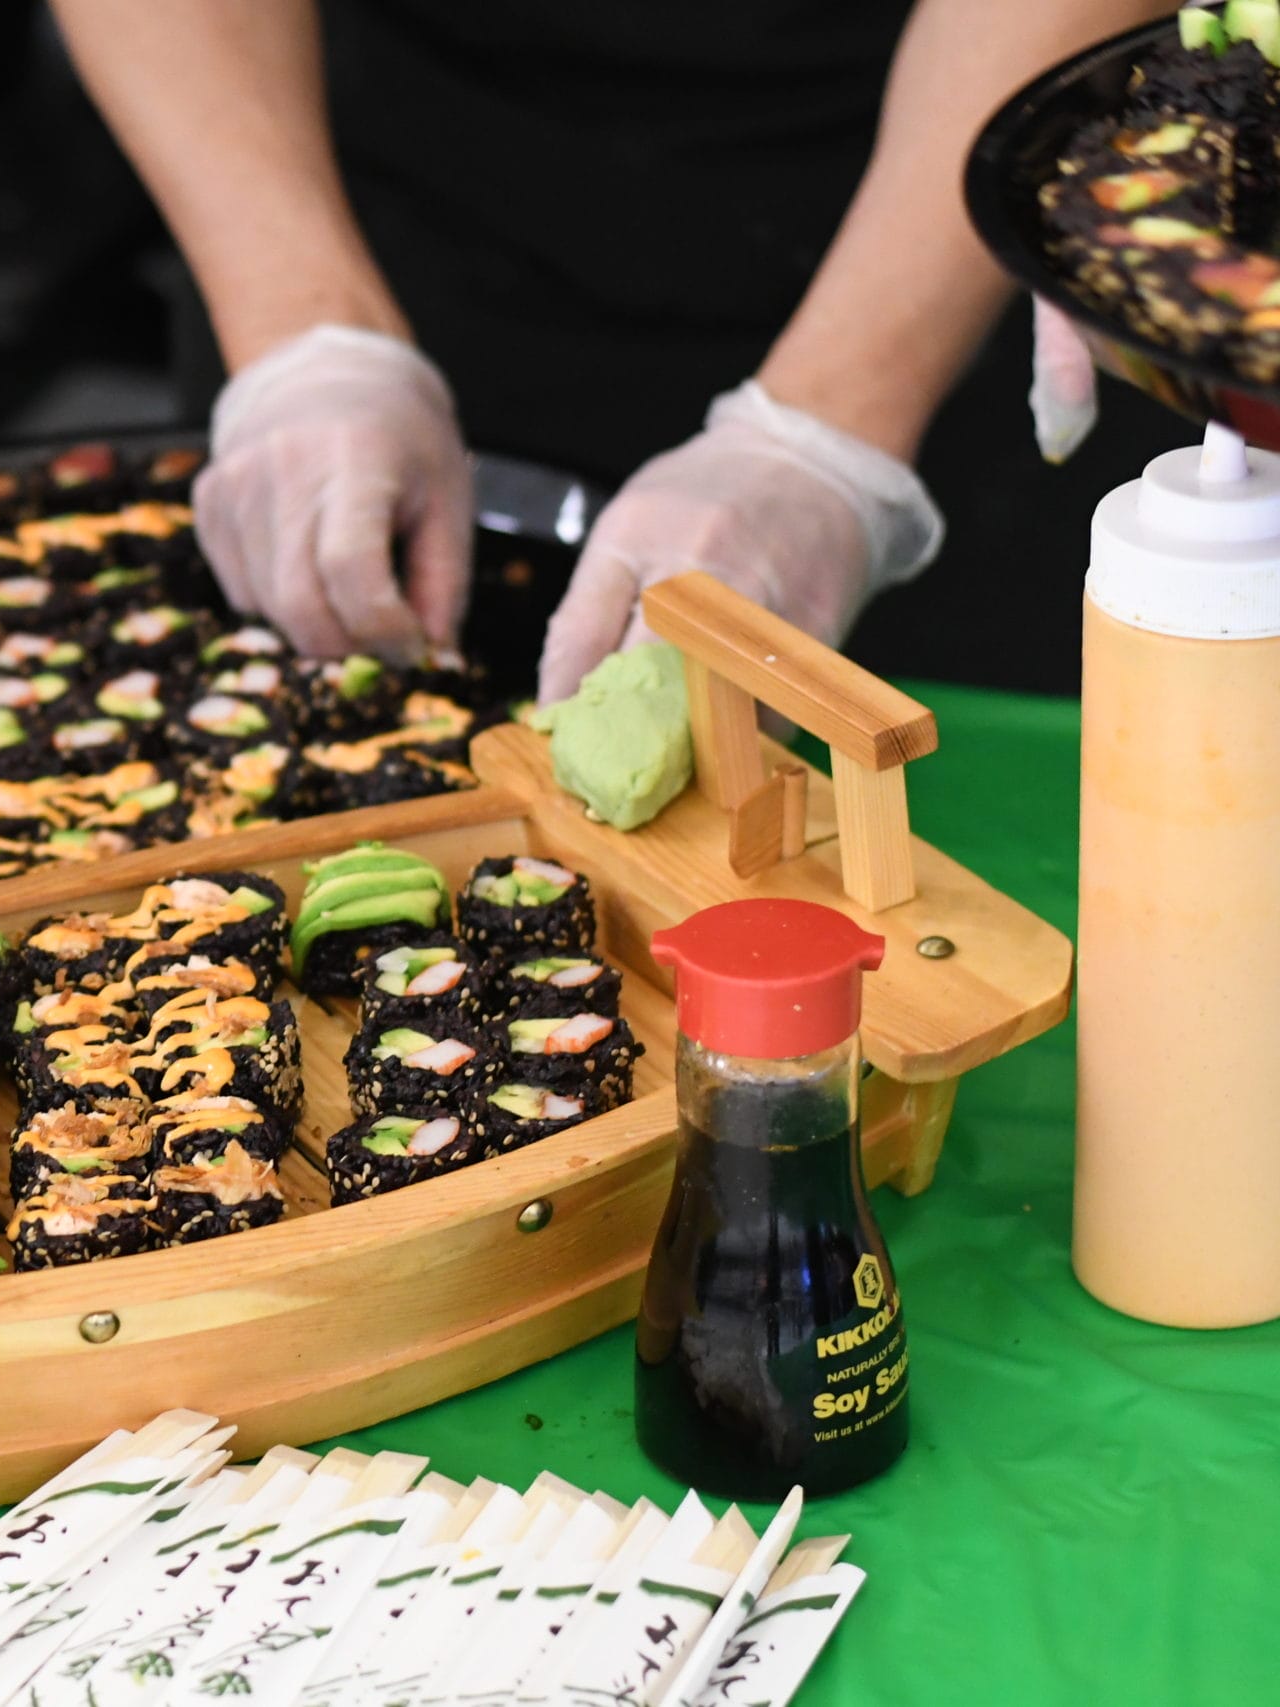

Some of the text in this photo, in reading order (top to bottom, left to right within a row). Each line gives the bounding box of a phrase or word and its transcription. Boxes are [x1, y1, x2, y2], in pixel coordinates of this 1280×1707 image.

[813, 1384, 870, 1418] Soy
[875, 1344, 909, 1395] Sau
[826, 1346, 888, 1384] NATURALLY
[814, 1420, 864, 1443] Visit us at
